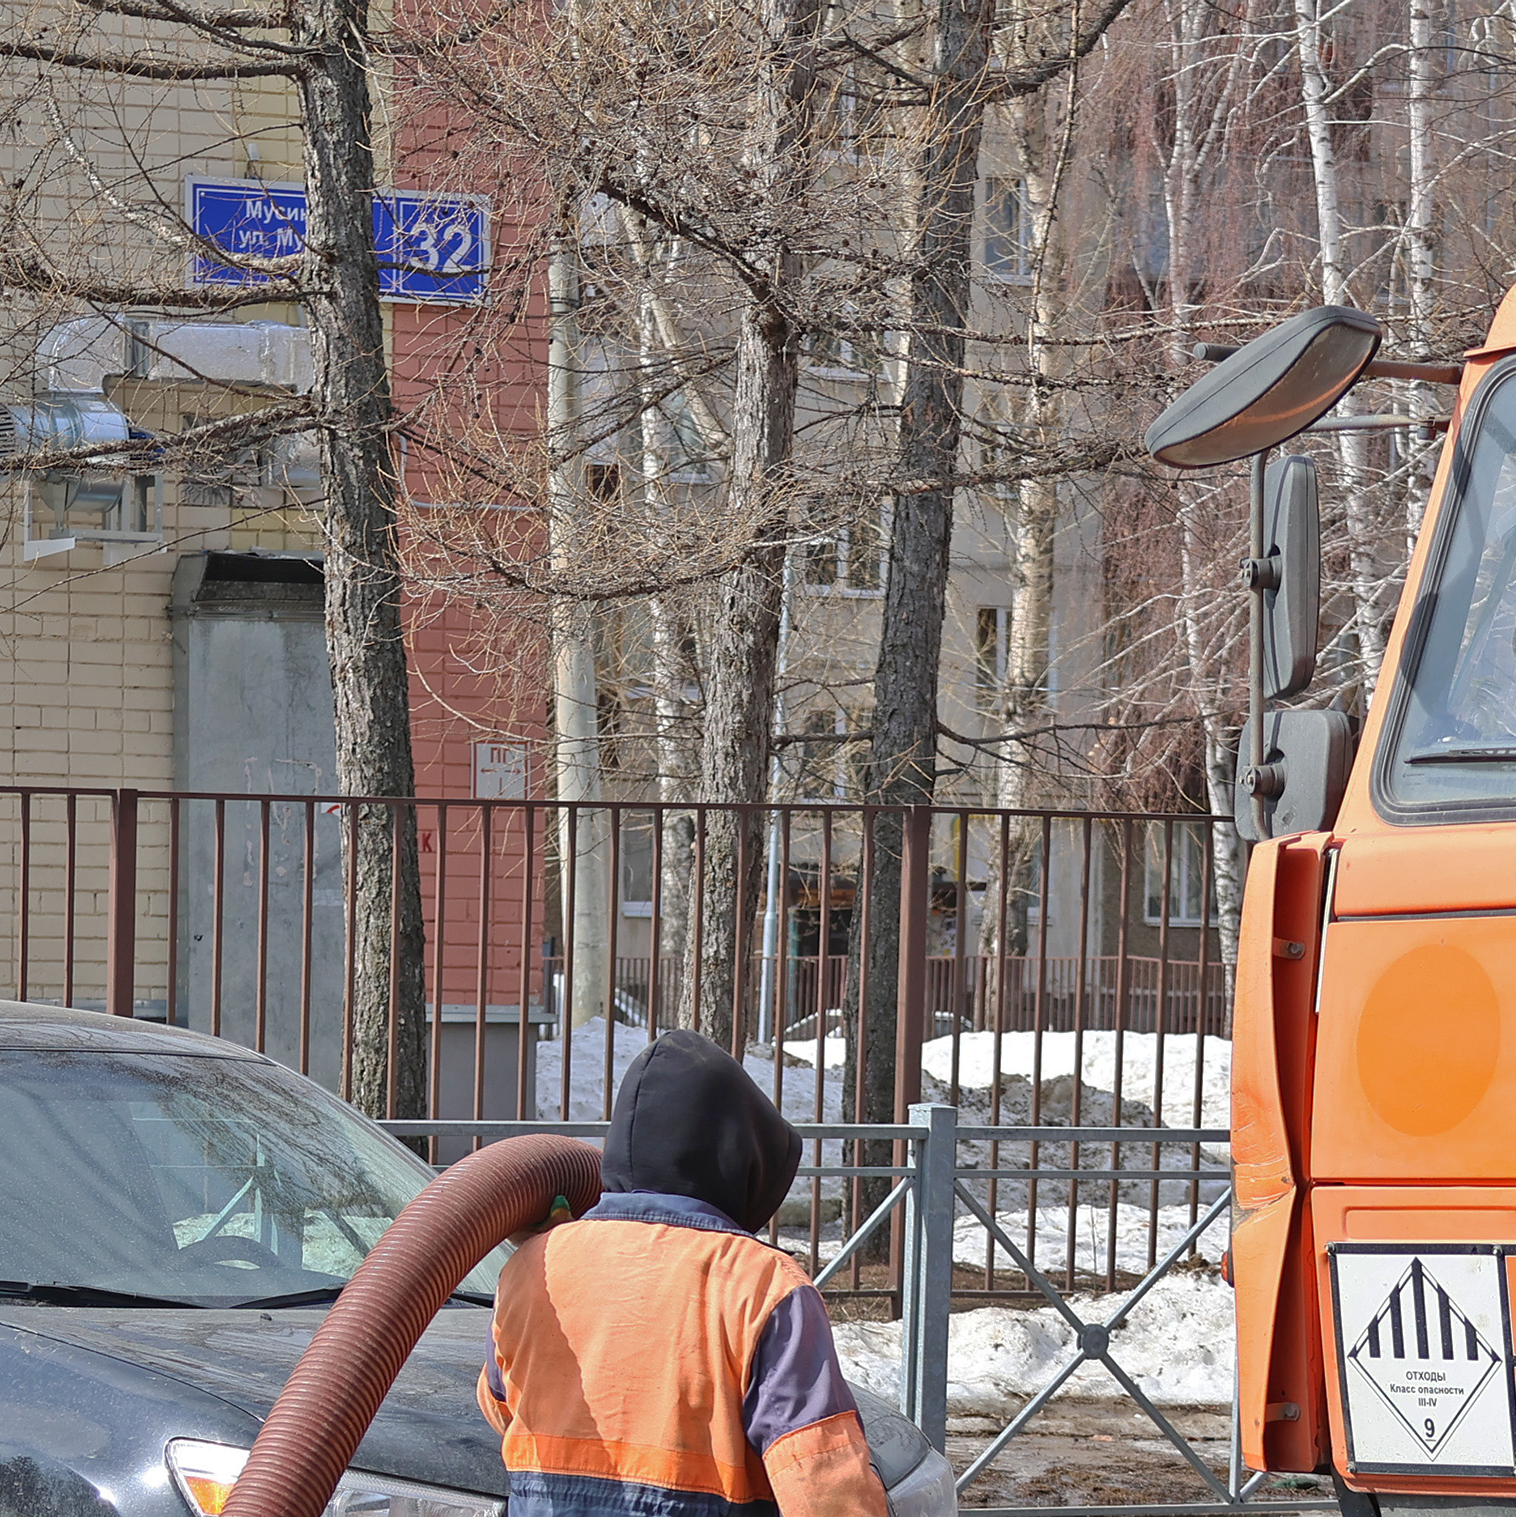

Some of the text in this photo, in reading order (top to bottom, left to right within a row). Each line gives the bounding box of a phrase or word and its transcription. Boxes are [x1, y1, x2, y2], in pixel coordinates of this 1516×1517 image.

[239, 229, 270, 249] ул.
[409, 221, 472, 273] 32
[1405, 1371, 1446, 1382] ОТХОДЫ
[1390, 1384, 1464, 1395] Класс опасности
[1424, 1418, 1435, 1437] 9
